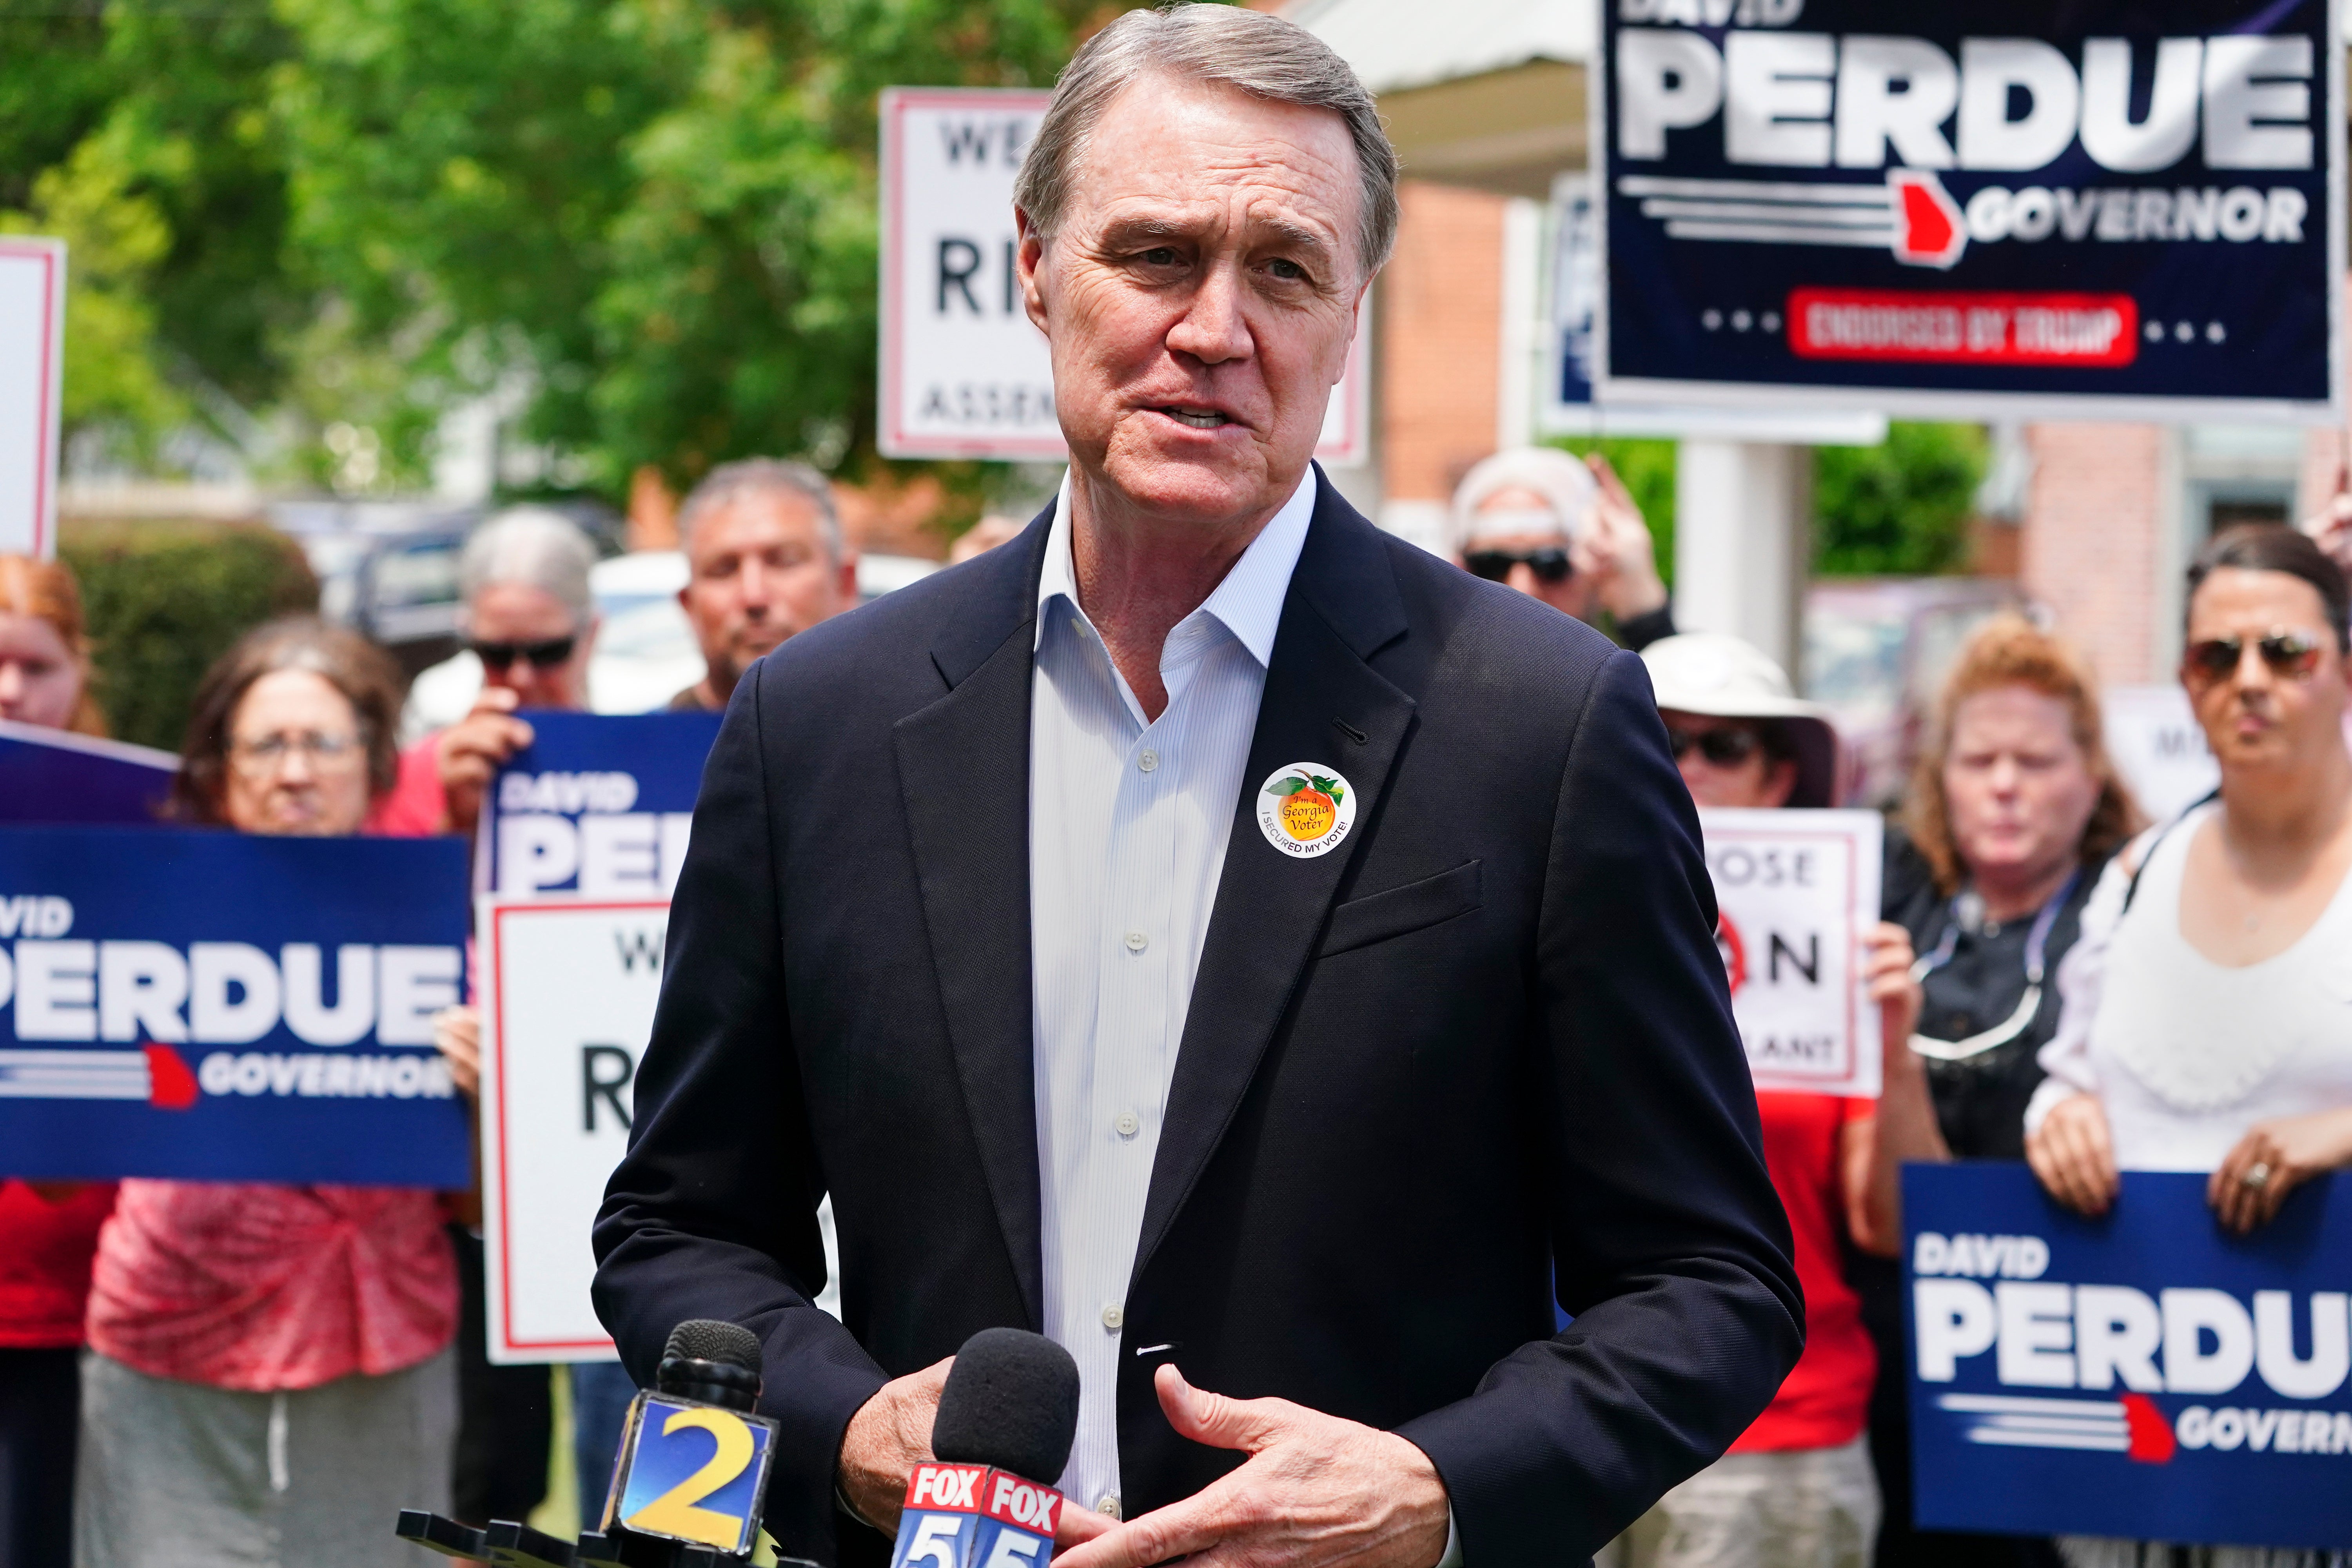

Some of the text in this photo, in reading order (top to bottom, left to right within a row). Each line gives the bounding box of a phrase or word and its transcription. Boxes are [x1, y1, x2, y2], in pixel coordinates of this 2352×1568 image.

[1616, 27, 2314, 172] PERDUE
[1965, 186, 2308, 243] GOVERNOR
[498, 770, 639, 814] DAVID
[1282, 804, 1330, 821] Georgia
[1263, 817, 1302, 852] SECURED
[1305, 844, 1321, 853] MY
[1322, 821, 1348, 846] VOTE!
[1290, 819, 1323, 831] Voter
[1707, 846, 1817, 887] OSE
[0, 939, 463, 1047] ERDUE
[199, 1051, 456, 1099] GOVERNOR
[1914, 1232, 2050, 1279] DAVID
[1913, 1278, 2352, 1399] PERDU
[625, 1407, 755, 1550] 2
[913, 1467, 980, 1508] FOX
[991, 1476, 1058, 1532] FOX
[907, 1515, 963, 1568] 5
